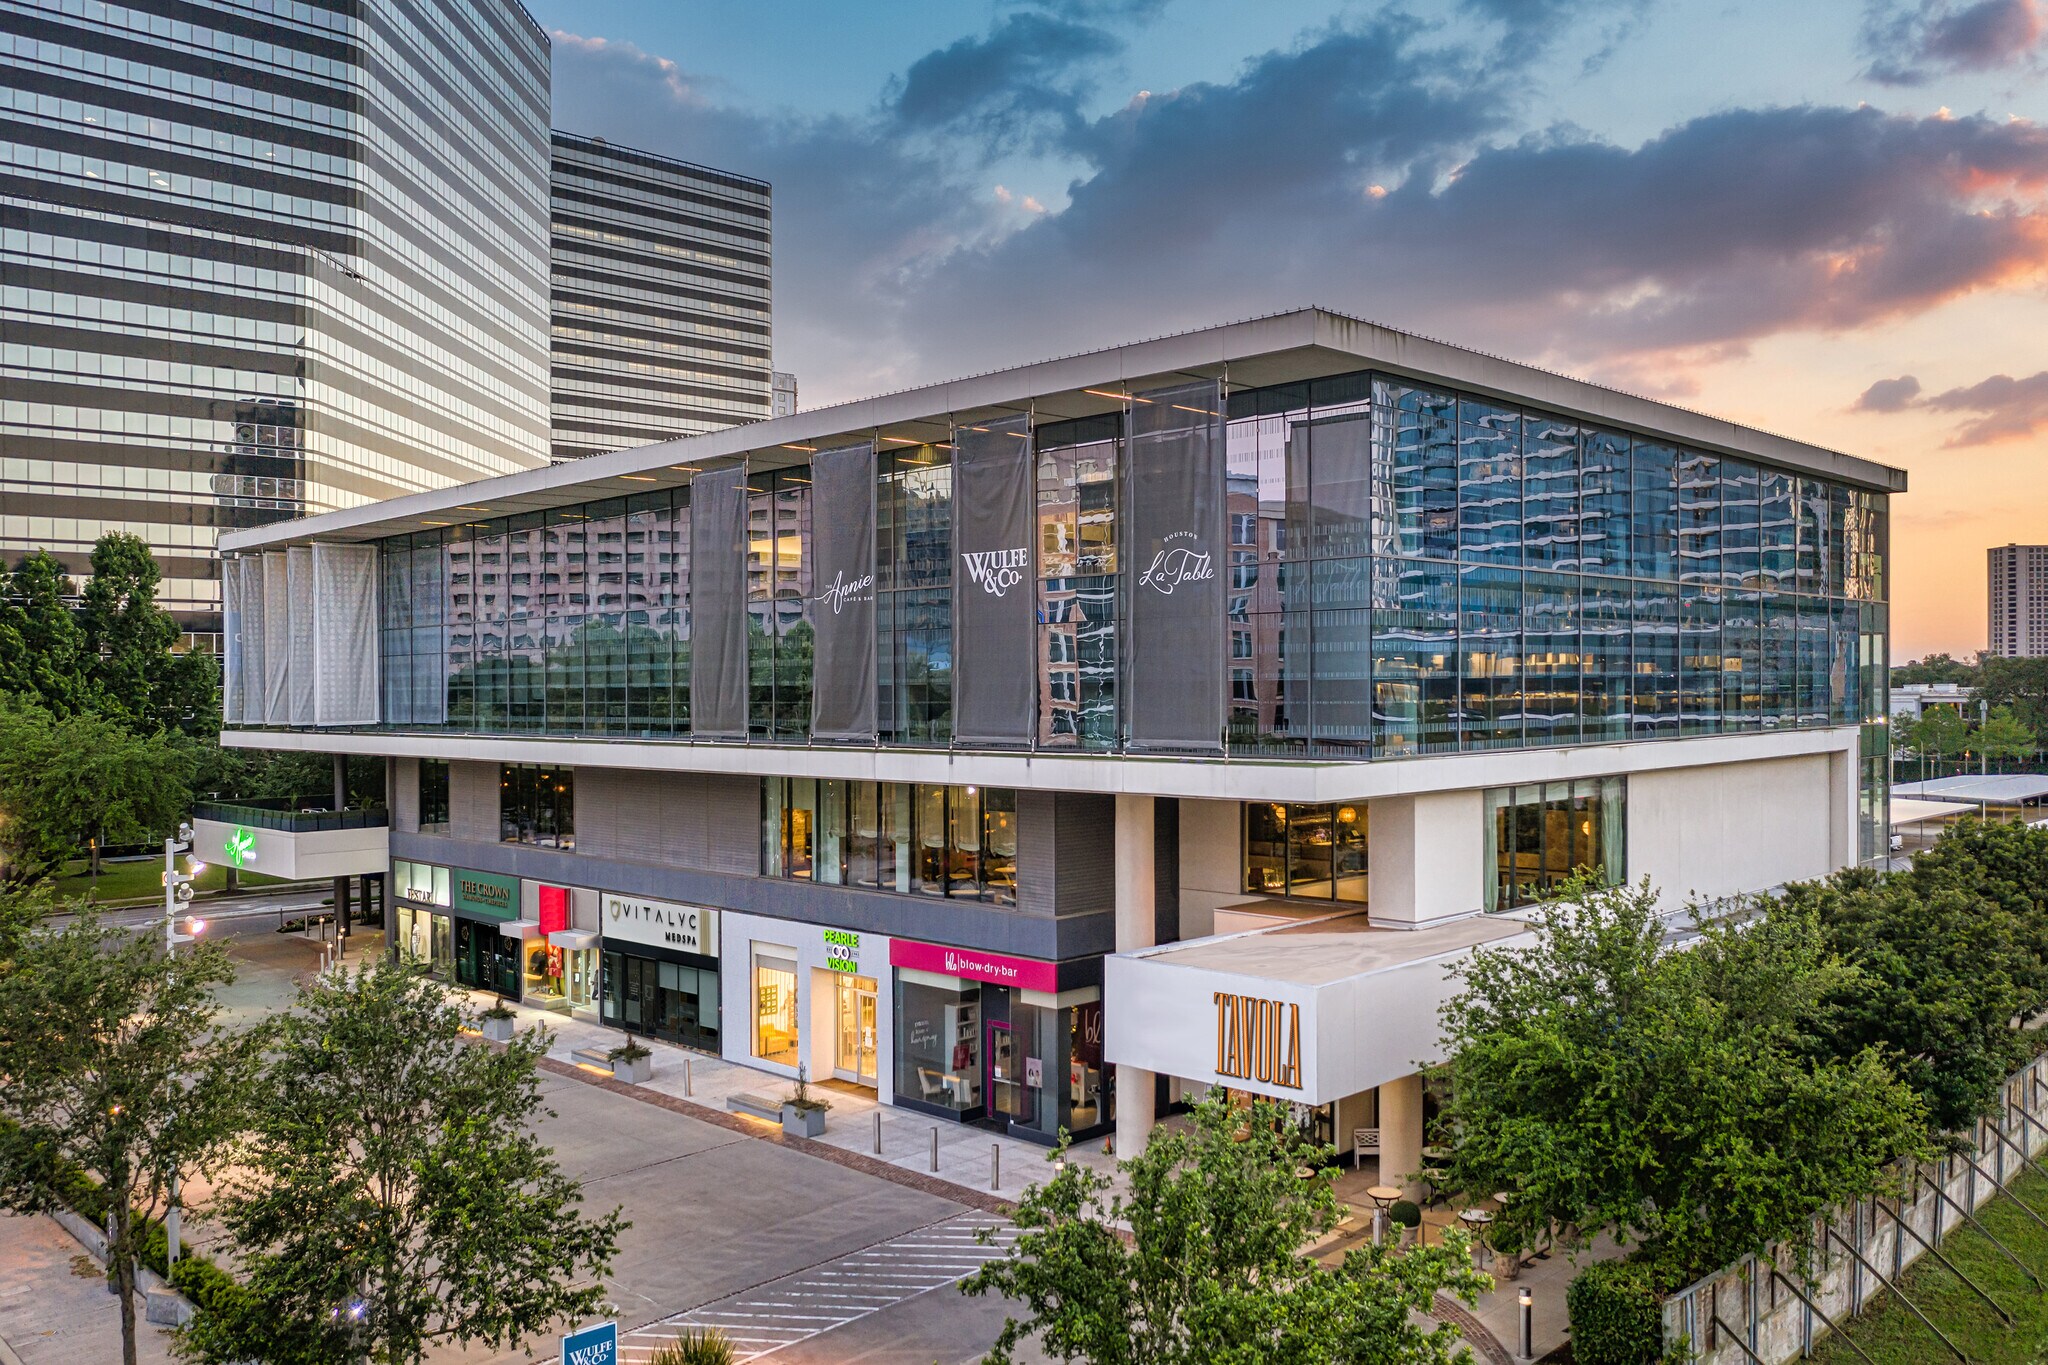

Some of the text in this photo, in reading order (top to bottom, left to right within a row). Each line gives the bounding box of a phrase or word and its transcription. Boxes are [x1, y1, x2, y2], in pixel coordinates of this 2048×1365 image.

[1163, 531, 1198, 543] HOUSTON
[960, 547, 1028, 584] WULFE
[1138, 548, 1215, 595] La Table
[813, 570, 875, 615] Annie
[460, 880, 511, 901] THE CROWN
[665, 931, 697, 946] MEDSPA
[823, 929, 860, 948] PEARLE
[826, 957, 858, 973] VISION
[945, 951, 957, 971] blo
[1213, 991, 1303, 1091] TAVOLA
[568, 1339, 613, 1365] WULFE
